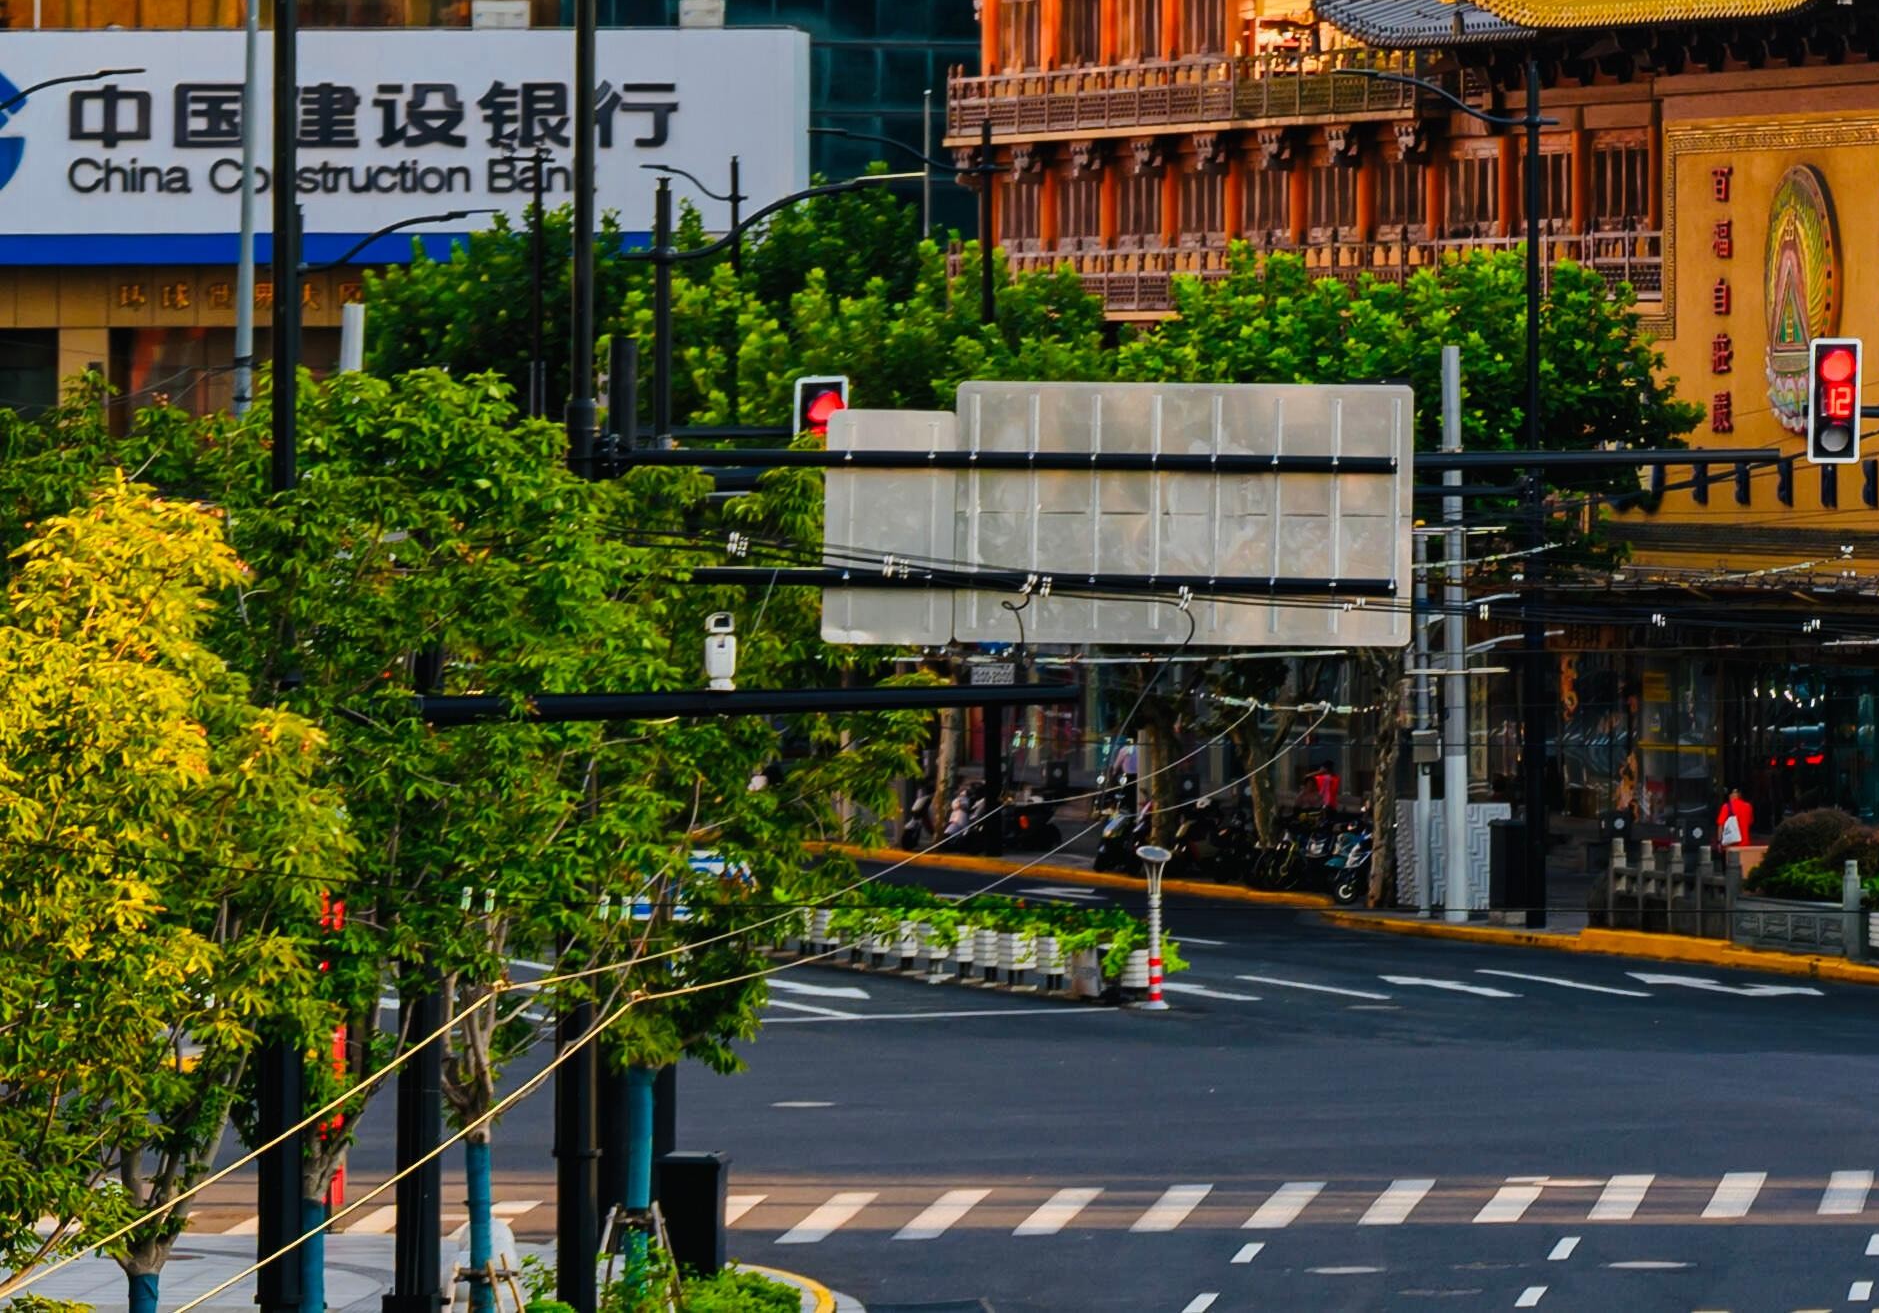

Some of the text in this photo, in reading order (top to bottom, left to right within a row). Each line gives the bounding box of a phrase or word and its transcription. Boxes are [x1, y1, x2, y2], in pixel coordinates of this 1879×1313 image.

[69, 81, 680, 148] 中国建设银行
[68, 158, 598, 194] China Costruction Ban
[1829, 386, 1852, 417] 12
